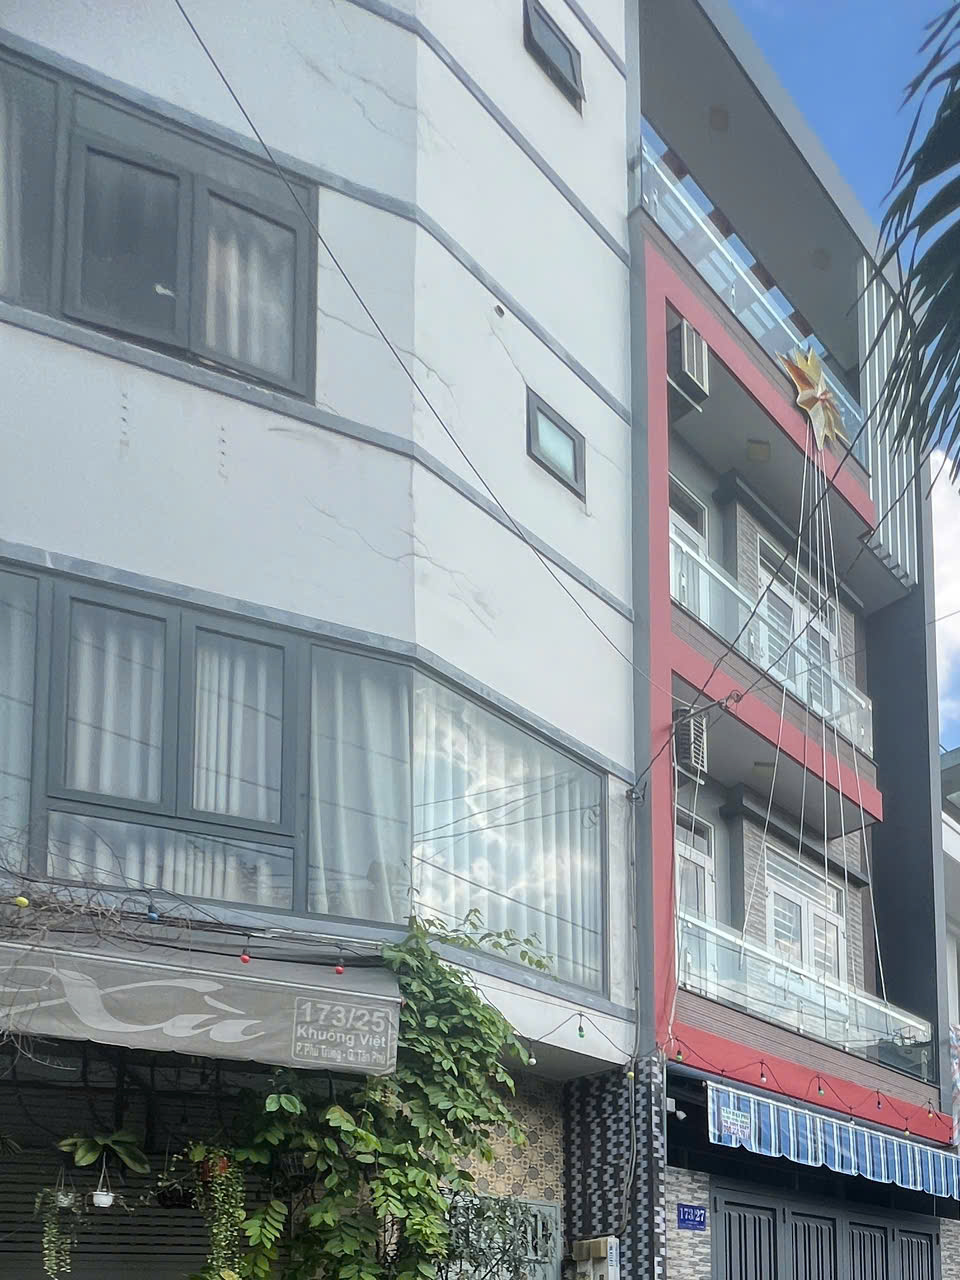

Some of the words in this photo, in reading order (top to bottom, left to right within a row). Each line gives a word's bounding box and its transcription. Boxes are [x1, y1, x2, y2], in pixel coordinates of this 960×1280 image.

[301, 1001, 386, 1032] 173/25
[360, 1033, 386, 1049] Việt
[680, 1207, 705, 1222] 173/27
